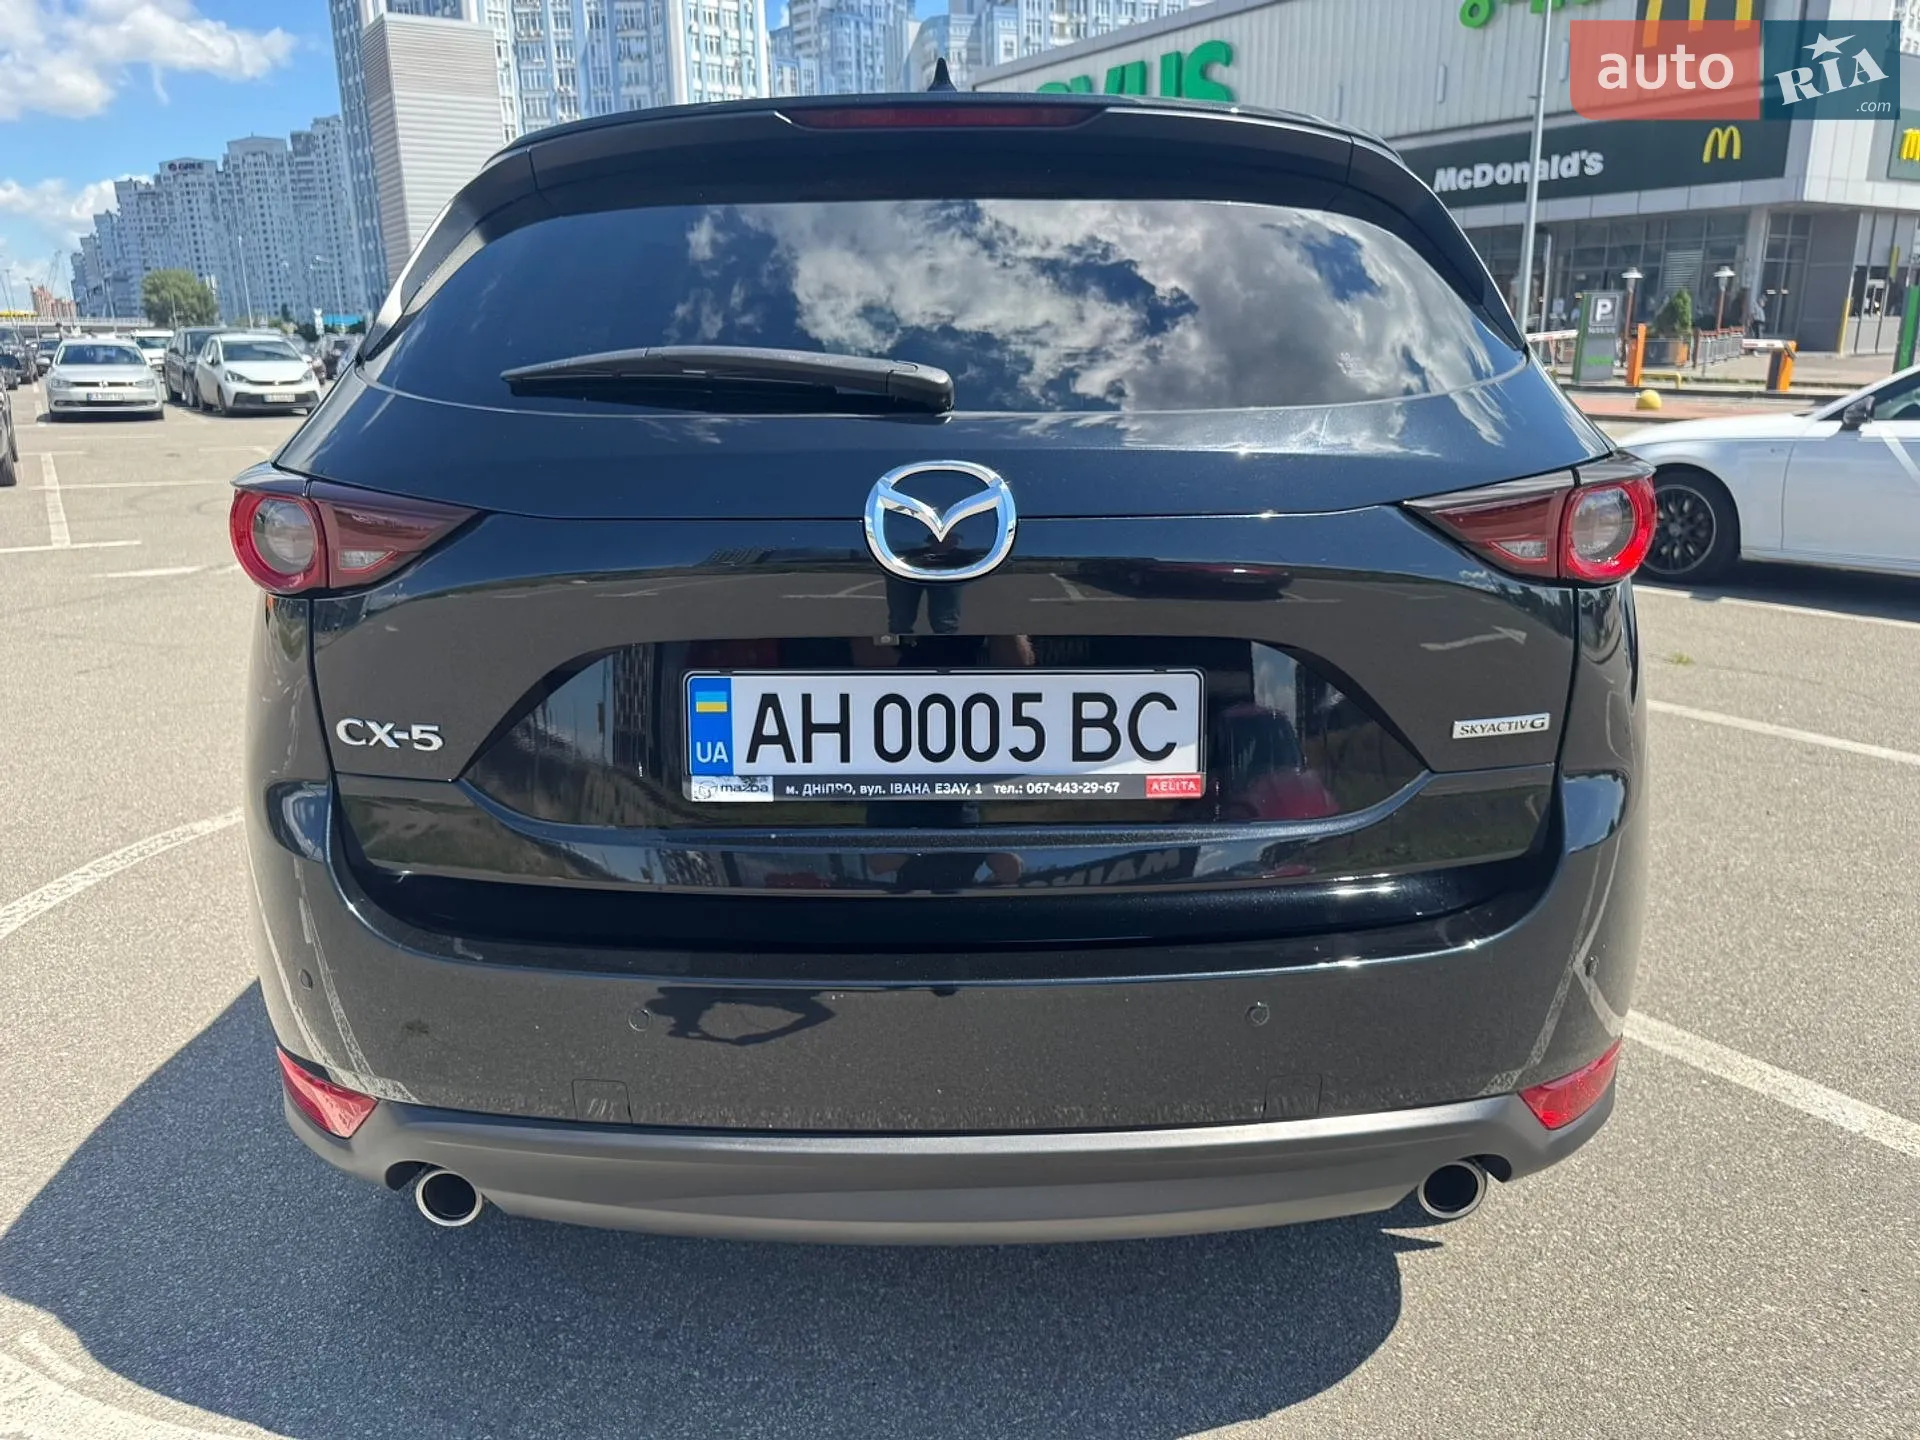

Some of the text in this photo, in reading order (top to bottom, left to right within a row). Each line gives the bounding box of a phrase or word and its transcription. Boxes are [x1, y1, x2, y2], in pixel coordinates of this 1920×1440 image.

[1433, 149, 1604, 193] McDonald's
[336, 717, 444, 751] CX-5
[746, 691, 1178, 764] AH 0005 BC
[696, 741, 729, 764] UA
[860, 784, 886, 797] вул.
[890, 782, 931, 795] ІВАНА
[975, 783, 983, 795] 1
[993, 784, 1023, 795] тел.:
[1026, 781, 1120, 795] 067-443-29-67
[1151, 780, 1197, 792] AELITA
